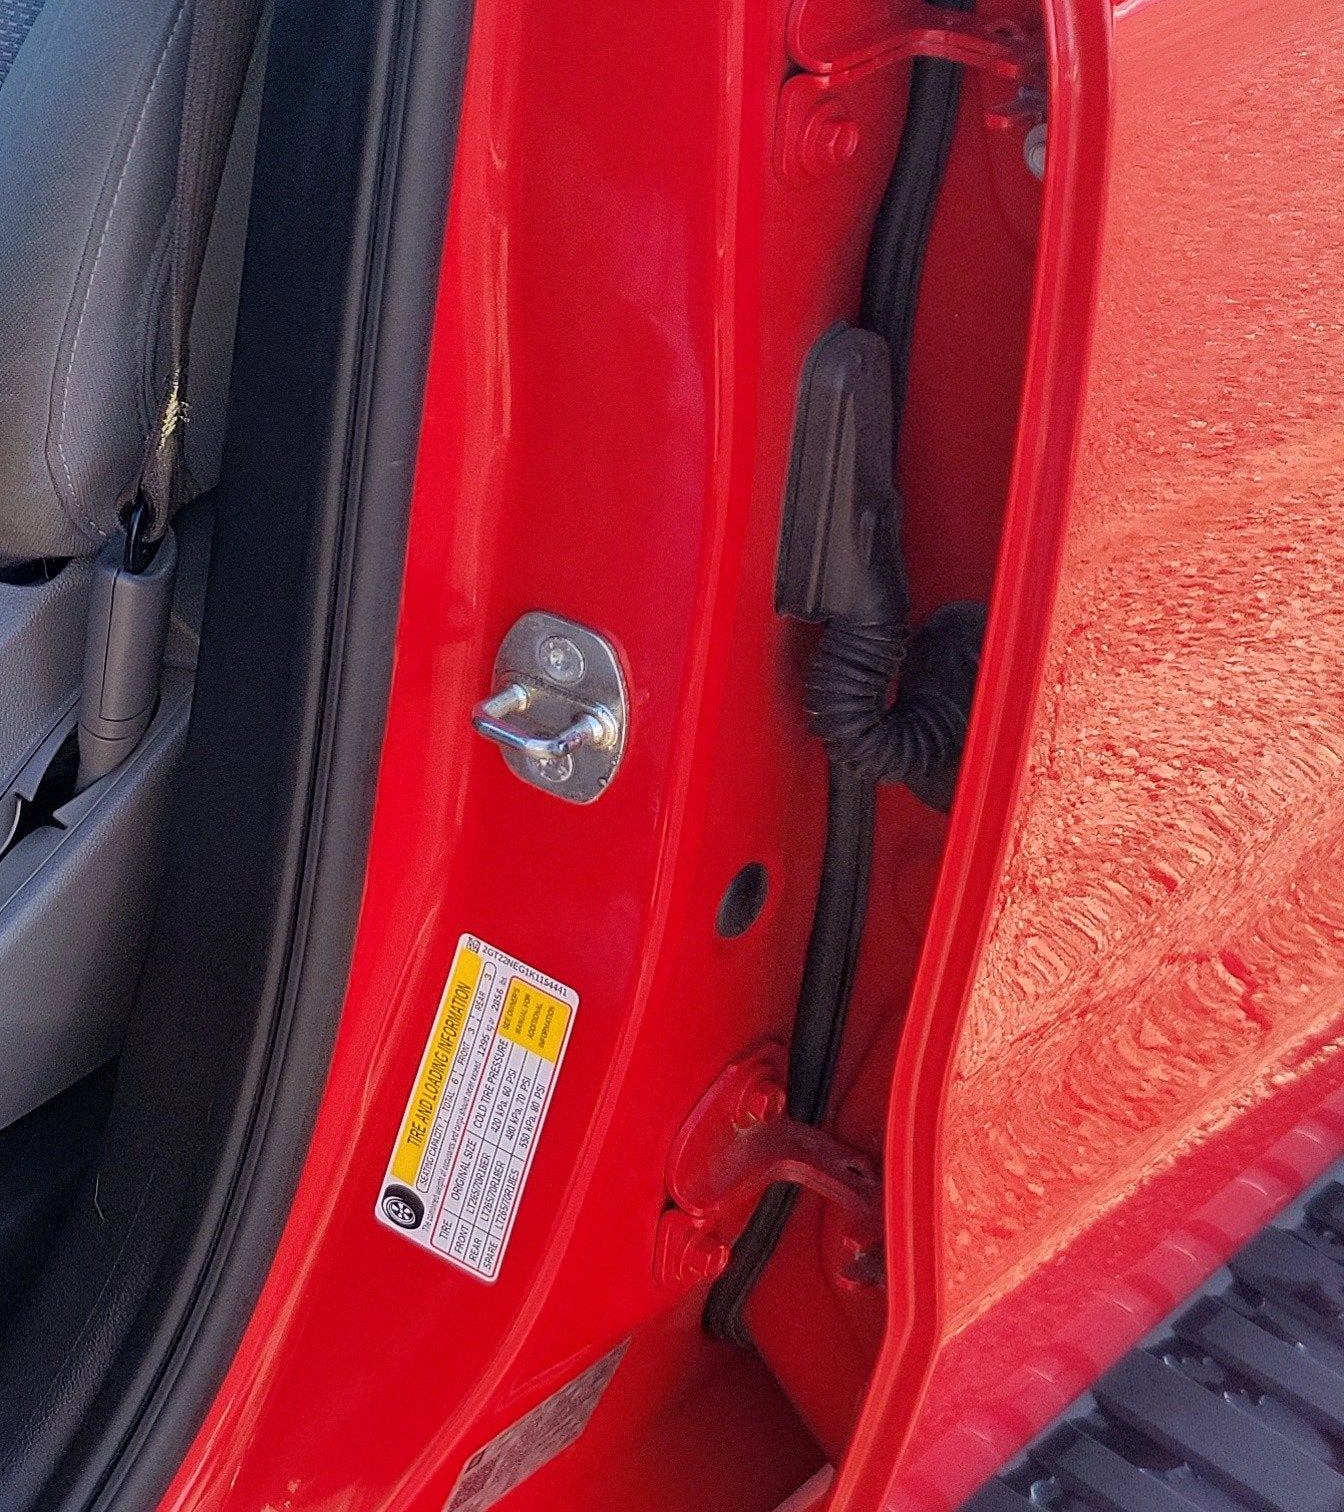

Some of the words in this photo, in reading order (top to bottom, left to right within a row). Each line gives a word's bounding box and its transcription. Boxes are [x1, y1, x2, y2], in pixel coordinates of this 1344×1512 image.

[474, 989, 486, 1011] REAR
[436, 979, 471, 1054] INFORMATION
[476, 1031, 490, 1057] 1295
[490, 986, 504, 1012] 2856
[456, 1040, 470, 1066] FRONT
[486, 1036, 509, 1085] PRESSURE
[421, 1049, 449, 1102] LOADING
[505, 1067, 517, 1085] PSI
[519, 1074, 531, 1092] PSI
[442, 1088, 455, 1113] TOTAL
[480, 1082, 495, 1105] TIRE
[501, 1084, 512, 1098] 60
[515, 1091, 526, 1105] 70
[413, 1096, 434, 1125] AND
[472, 1102, 488, 1129] COLD
[518, 1131, 530, 1149] 550
[533, 1082, 545, 1100] PSI
[406, 1121, 426, 1149] TIRE
[490, 1115, 502, 1134] 420
[504, 1123, 516, 1142] 480
[419, 1155, 434, 1186] SEATING
[428, 1122, 445, 1157] CAPACITY
[450, 1157, 470, 1202] ORIGINAL
[462, 1137, 477, 1160] SIZE
[438, 1218, 452, 1241] TIRE
[453, 1223, 469, 1254] FRONT
[468, 1235, 482, 1262] REAR
[482, 1239, 498, 1270] SPARE
